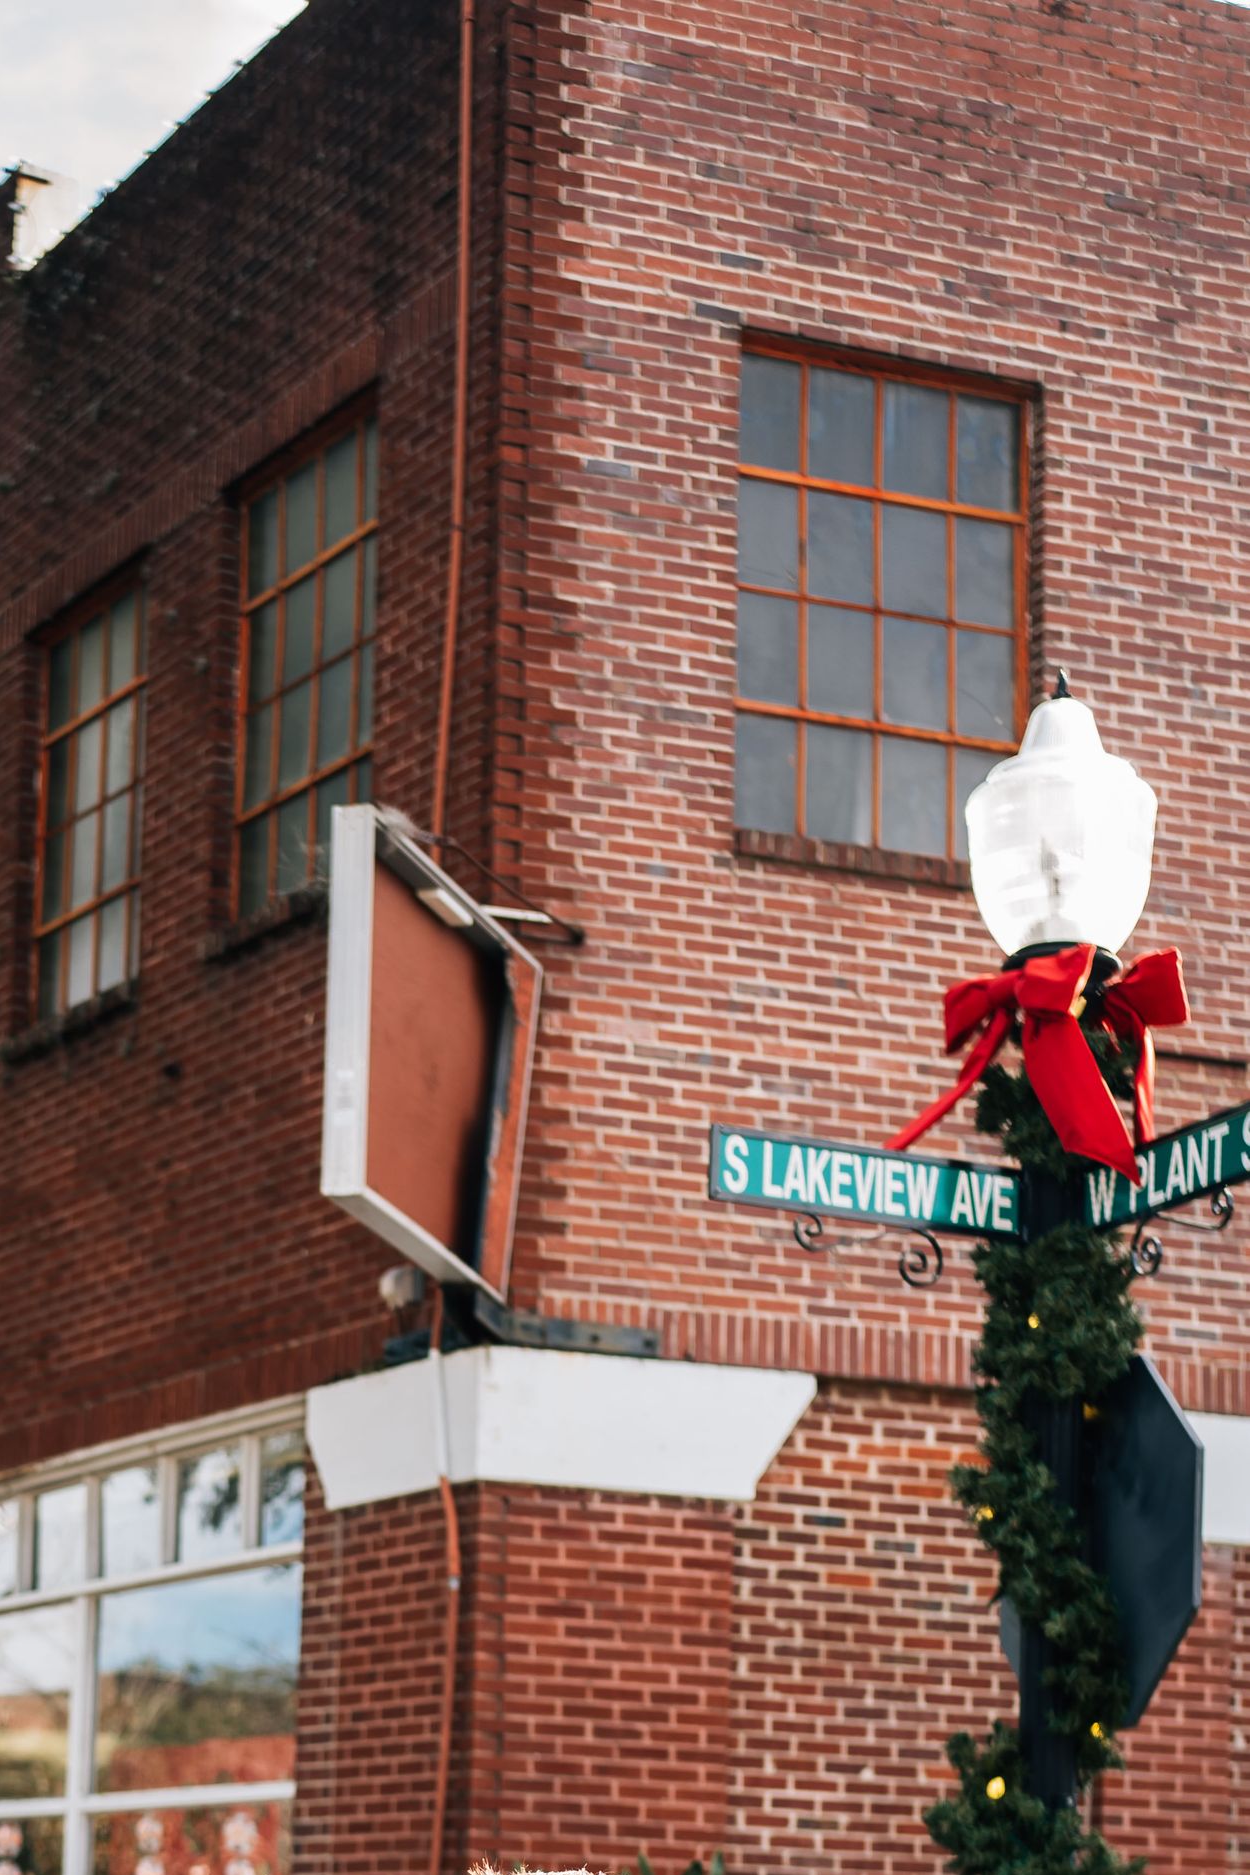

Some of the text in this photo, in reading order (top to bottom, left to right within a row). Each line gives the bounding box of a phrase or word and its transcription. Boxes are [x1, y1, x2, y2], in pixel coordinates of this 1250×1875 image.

[722, 1133, 1014, 1232] S LAKEVIEW AVE
[1088, 1166, 1118, 1226] W
[1129, 1121, 1230, 1214] PLANT
